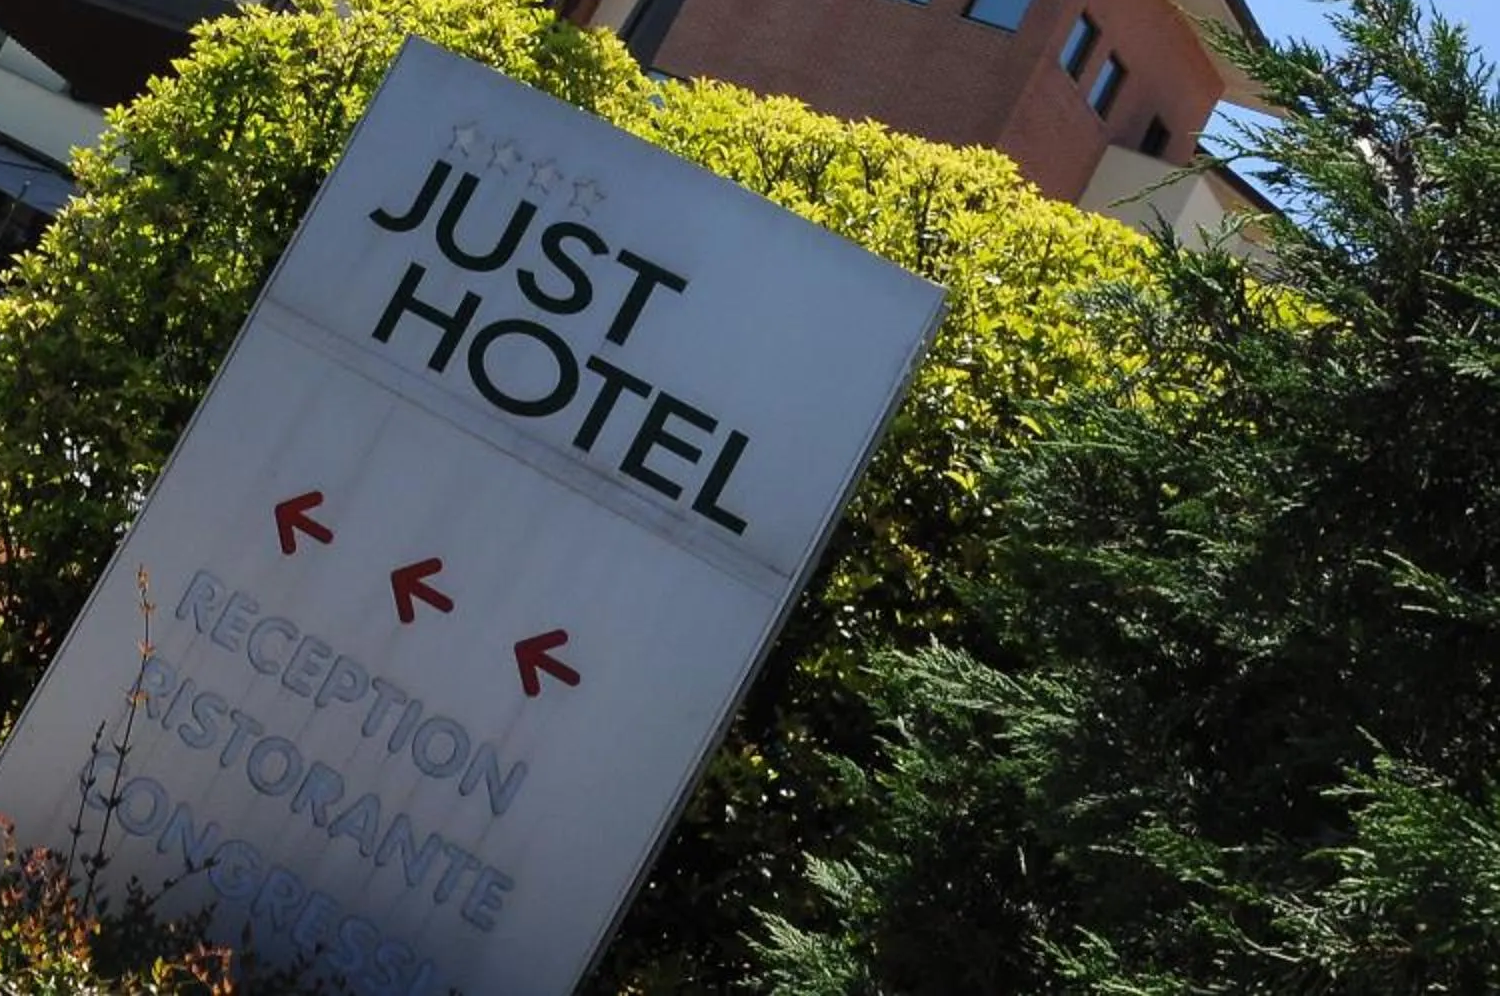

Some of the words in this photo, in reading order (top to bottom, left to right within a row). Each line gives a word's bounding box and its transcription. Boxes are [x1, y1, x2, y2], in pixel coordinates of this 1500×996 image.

[370, 160, 687, 348] JUST
[372, 263, 750, 536] HOTEL
[130, 657, 515, 932] RISTORANTE
[175, 569, 528, 816] RECEPTION
